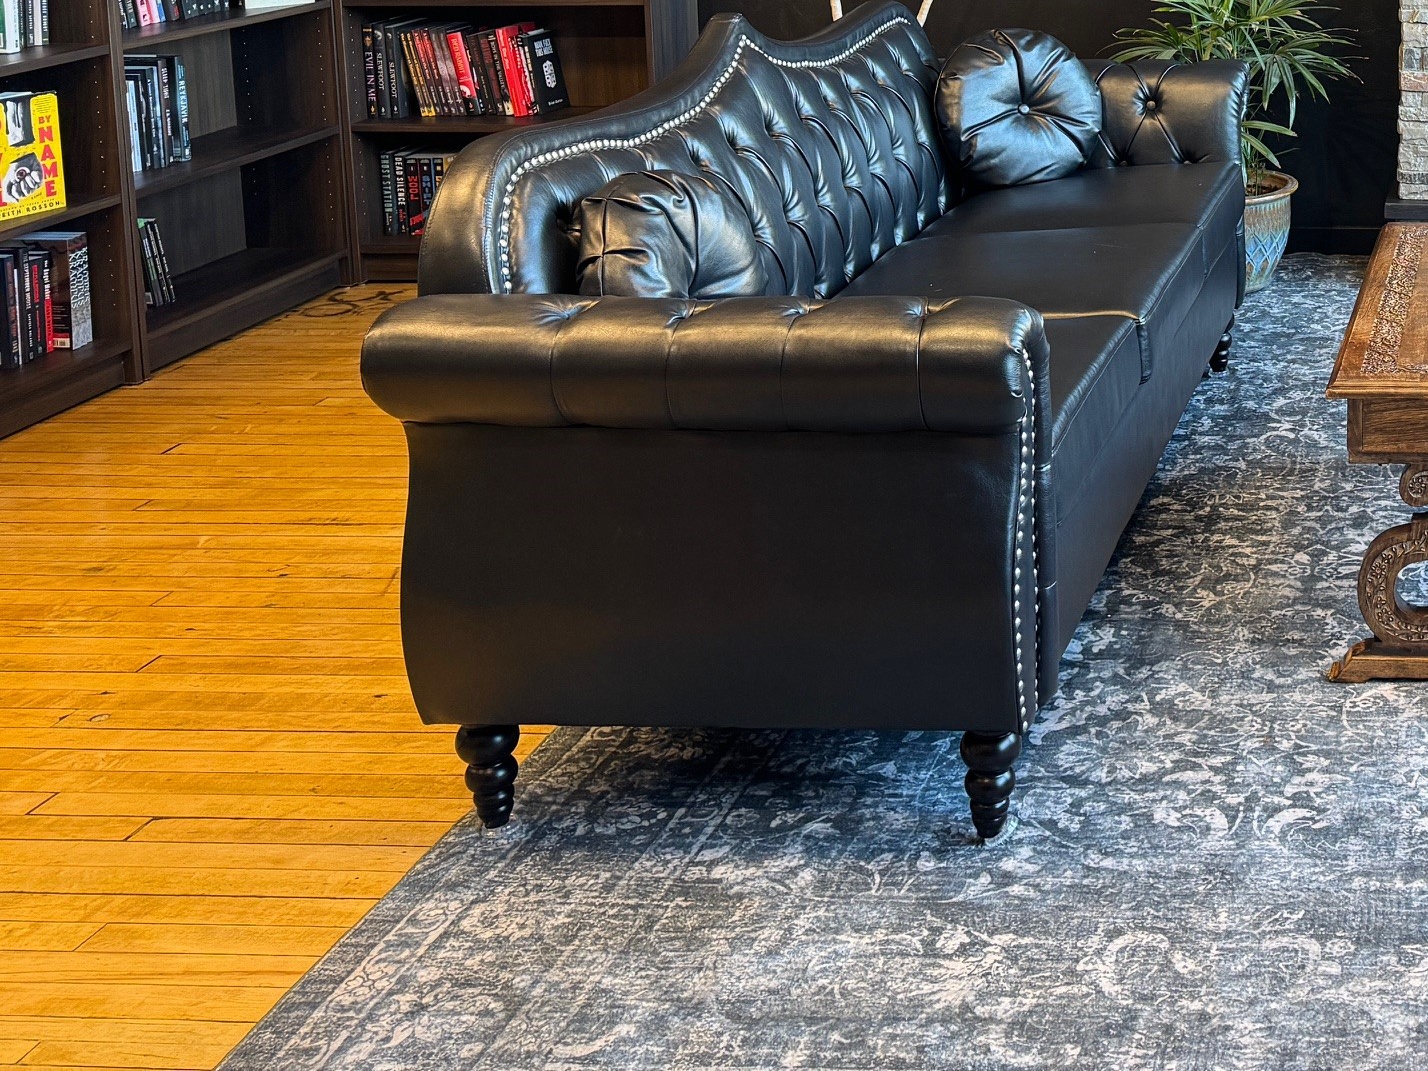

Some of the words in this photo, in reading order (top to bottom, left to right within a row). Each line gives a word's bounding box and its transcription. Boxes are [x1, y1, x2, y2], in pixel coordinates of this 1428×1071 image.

[450, 38, 459, 51] RED
[364, 52, 373, 71] EVIL
[376, 52, 385, 90] SLEWFOOT
[454, 52, 465, 74] RABBIT
[366, 75, 374, 85] IN
[388, 62, 397, 98] SLEWFOOT
[368, 88, 376, 102] ME
[38, 115, 51, 124] BY
[38, 126, 58, 198] NAME
[380, 155, 391, 179] GHOST
[394, 157, 403, 176] DEAD
[382, 179, 393, 212] STATION
[397, 177, 405, 205] SILENCE
[407, 176, 419, 200] WOOL
[0, 210, 21, 218] EITH
[26, 201, 60, 212] ROSSON
[68, 253, 78, 309] KRAMPUS
[75, 250, 85, 307] KRAMPUS
[81, 246, 90, 304] KRAMPUS
